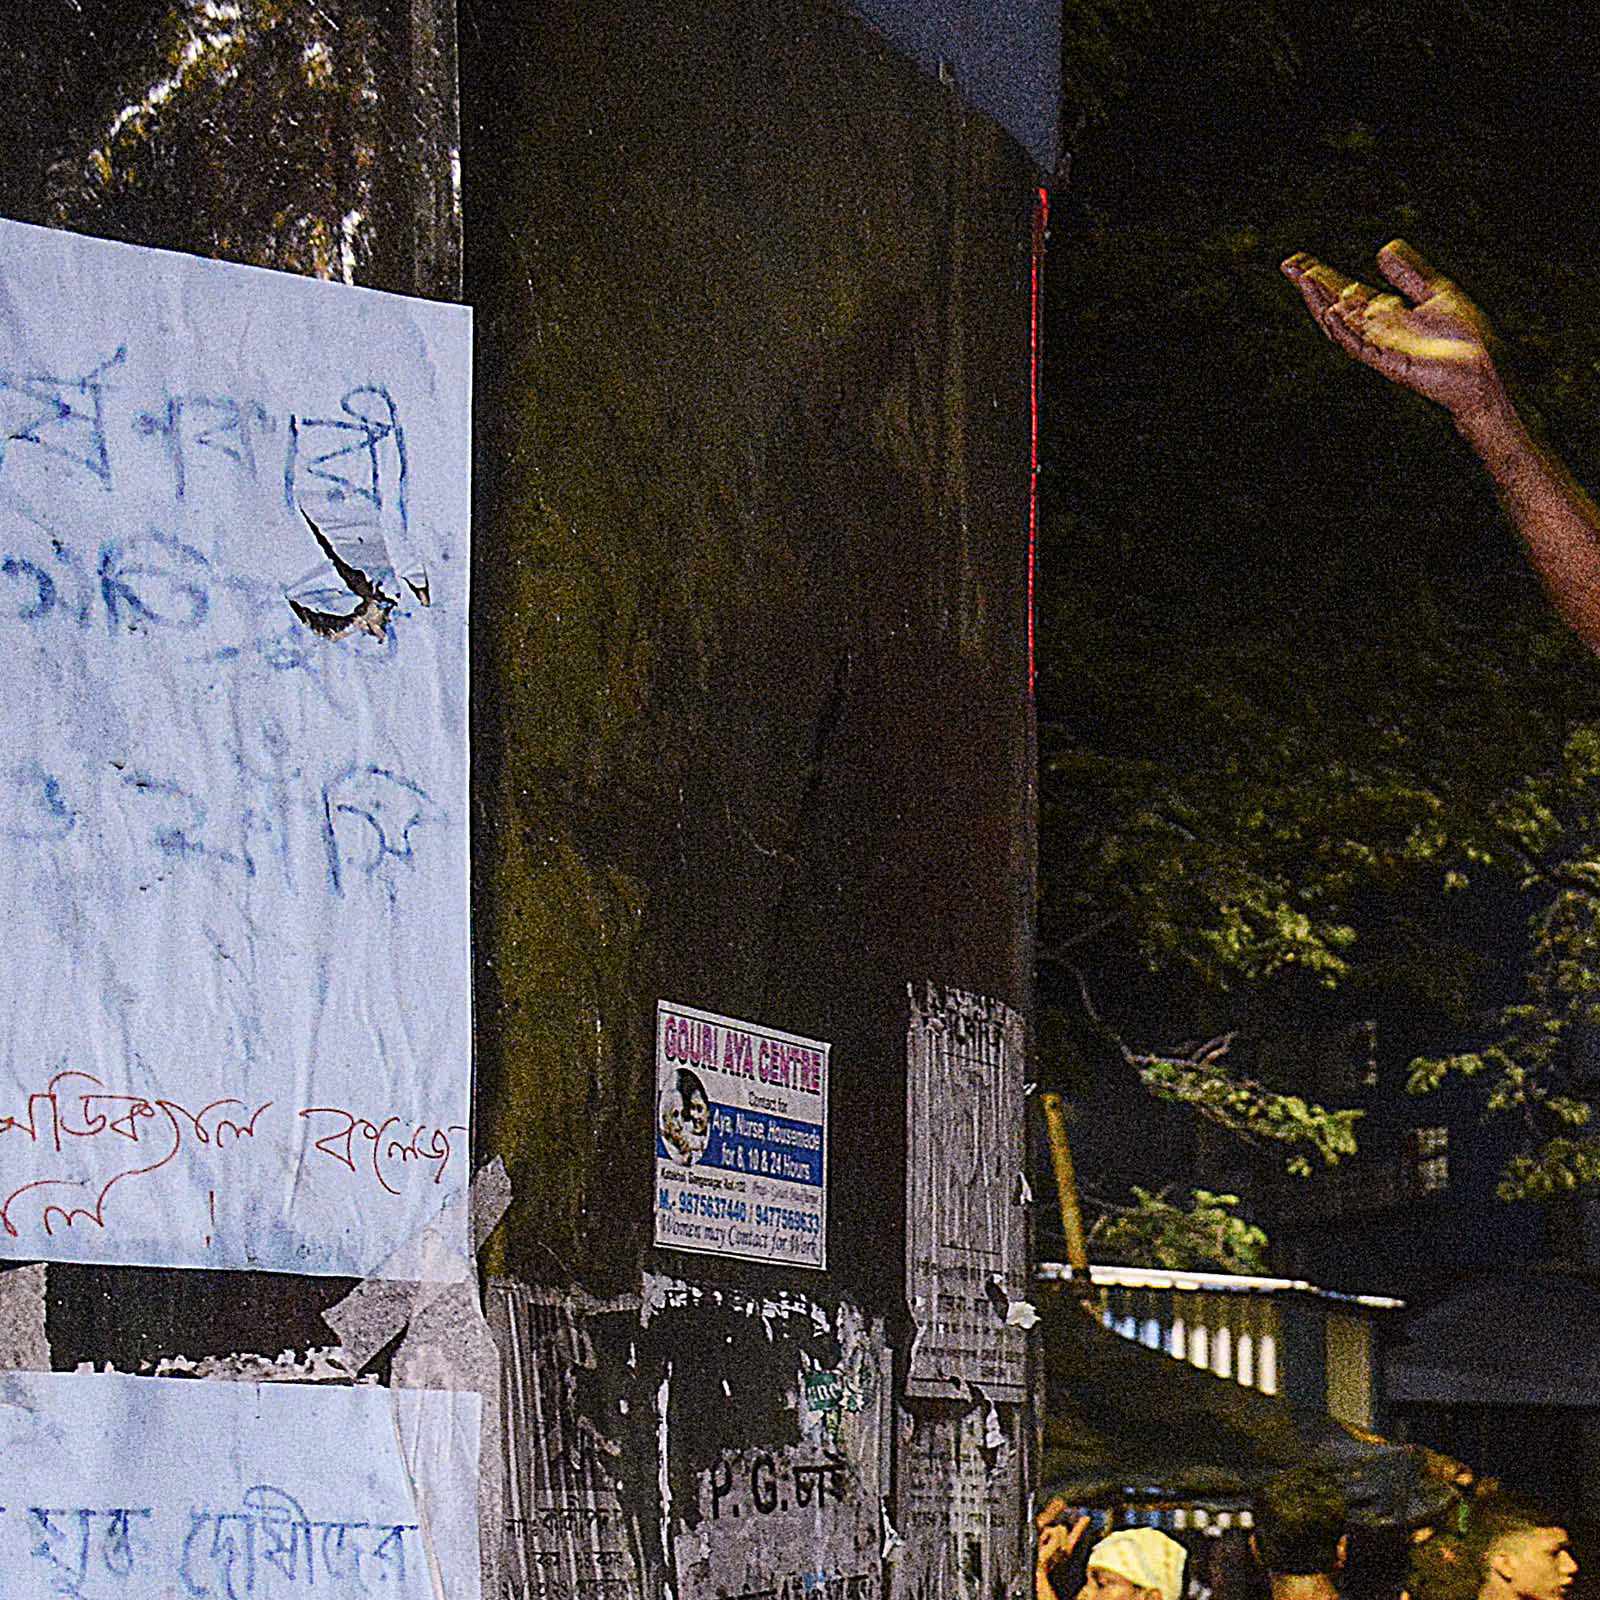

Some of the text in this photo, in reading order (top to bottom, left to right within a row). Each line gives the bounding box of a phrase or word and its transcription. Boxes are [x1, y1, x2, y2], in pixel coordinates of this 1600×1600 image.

[665, 1015, 821, 1096] GOURI AYA CENTRE
[783, 1154, 811, 1180] Hours
